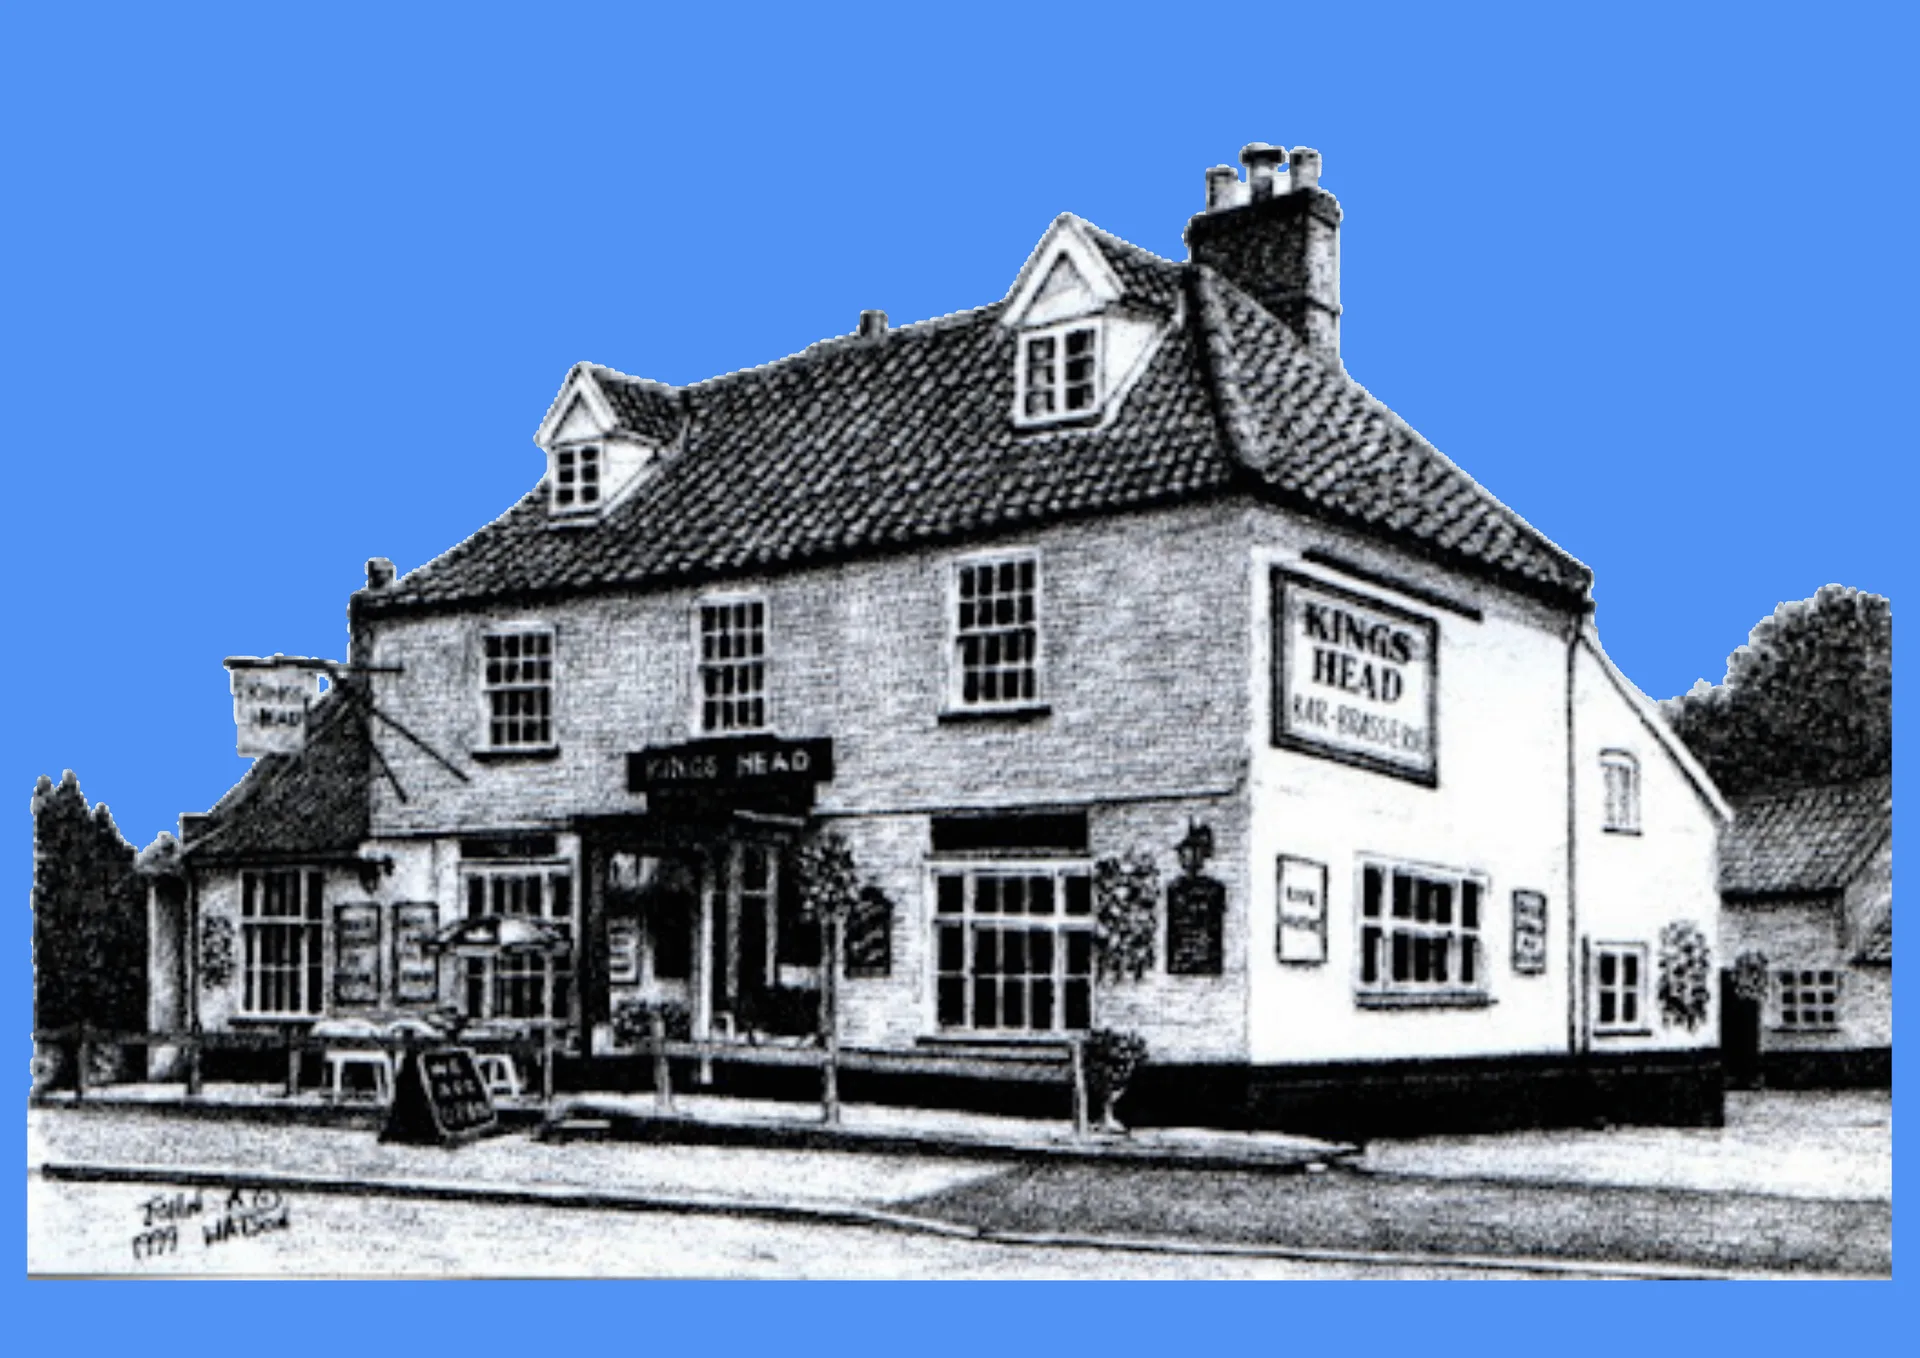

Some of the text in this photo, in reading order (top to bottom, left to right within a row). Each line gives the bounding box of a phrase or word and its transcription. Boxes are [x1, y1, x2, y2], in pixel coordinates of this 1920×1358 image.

[1302, 600, 1413, 665] KINGS
[1312, 646, 1404, 704] HEAD
[646, 748, 811, 781] KINGS HEAD
